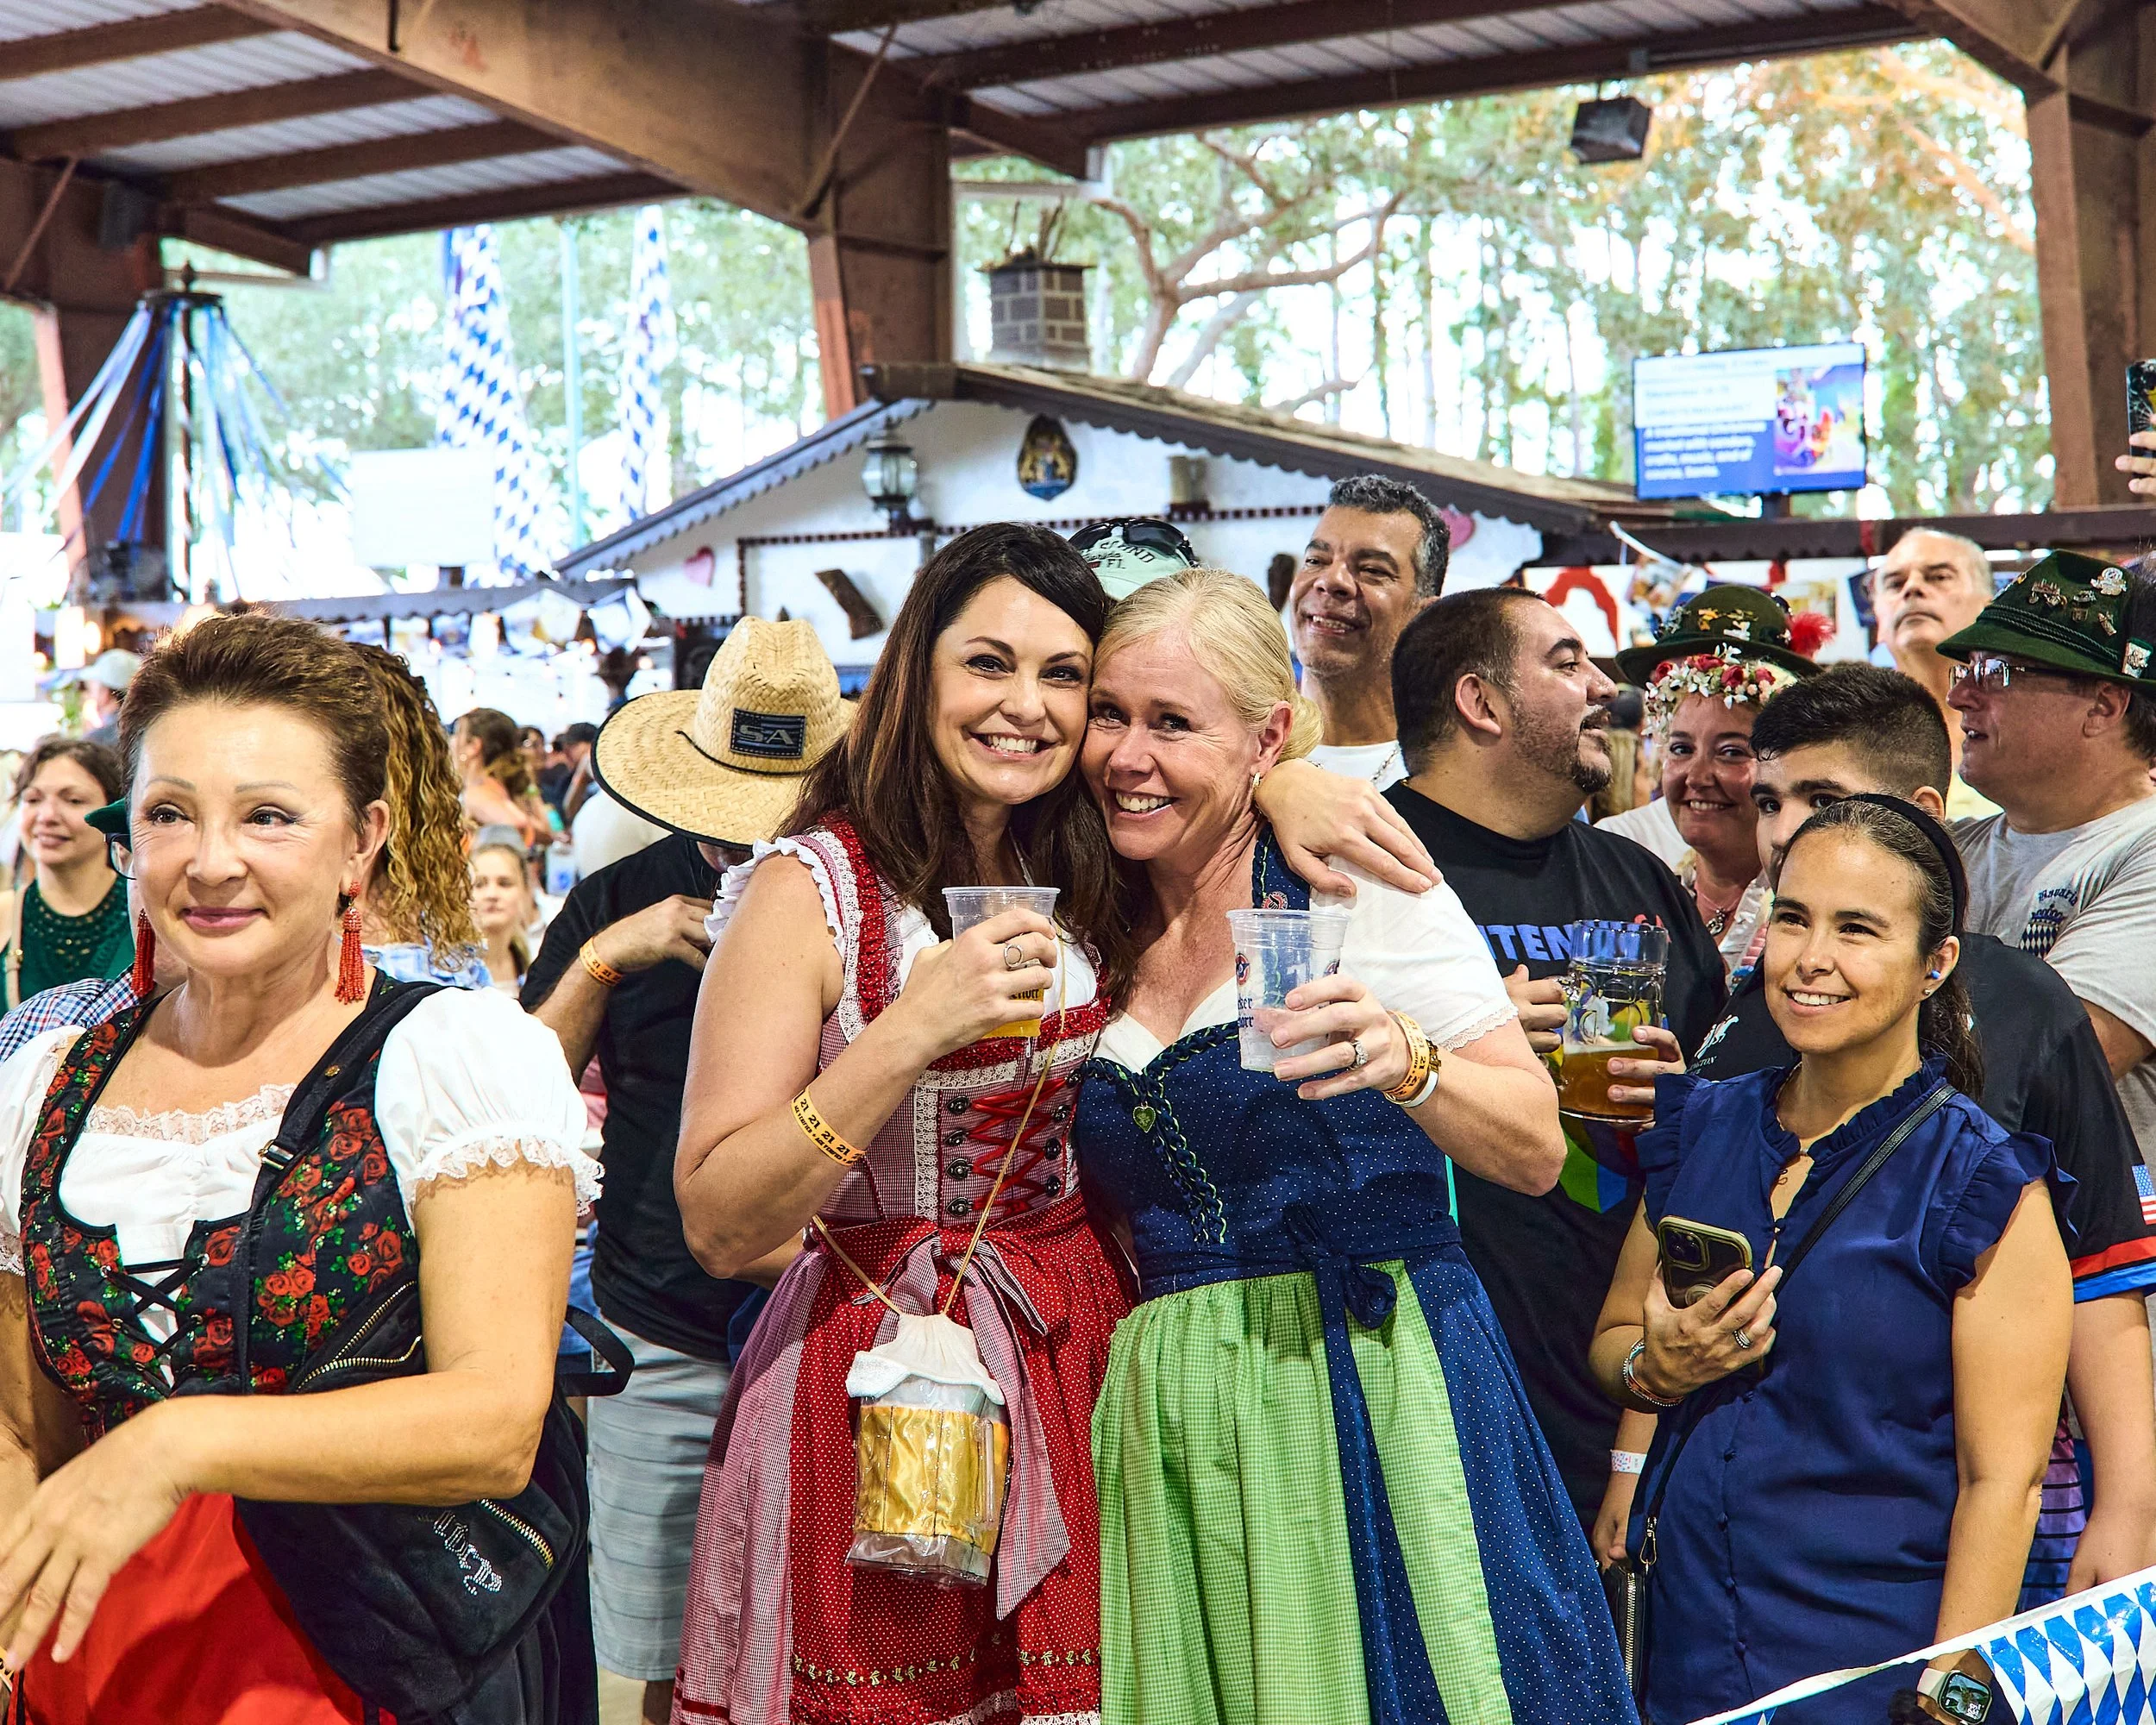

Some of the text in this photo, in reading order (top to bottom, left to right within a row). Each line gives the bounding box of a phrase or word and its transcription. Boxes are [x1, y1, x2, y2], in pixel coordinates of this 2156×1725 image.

[739, 724, 794, 746] SA
[2038, 888, 2078, 906] Bavaria
[592, 959, 601, 969] 21
[799, 1098, 810, 1113] 21
[808, 1114, 821, 1130] 21
[821, 1131, 836, 1145] 21
[836, 1144, 851, 1156] 21
